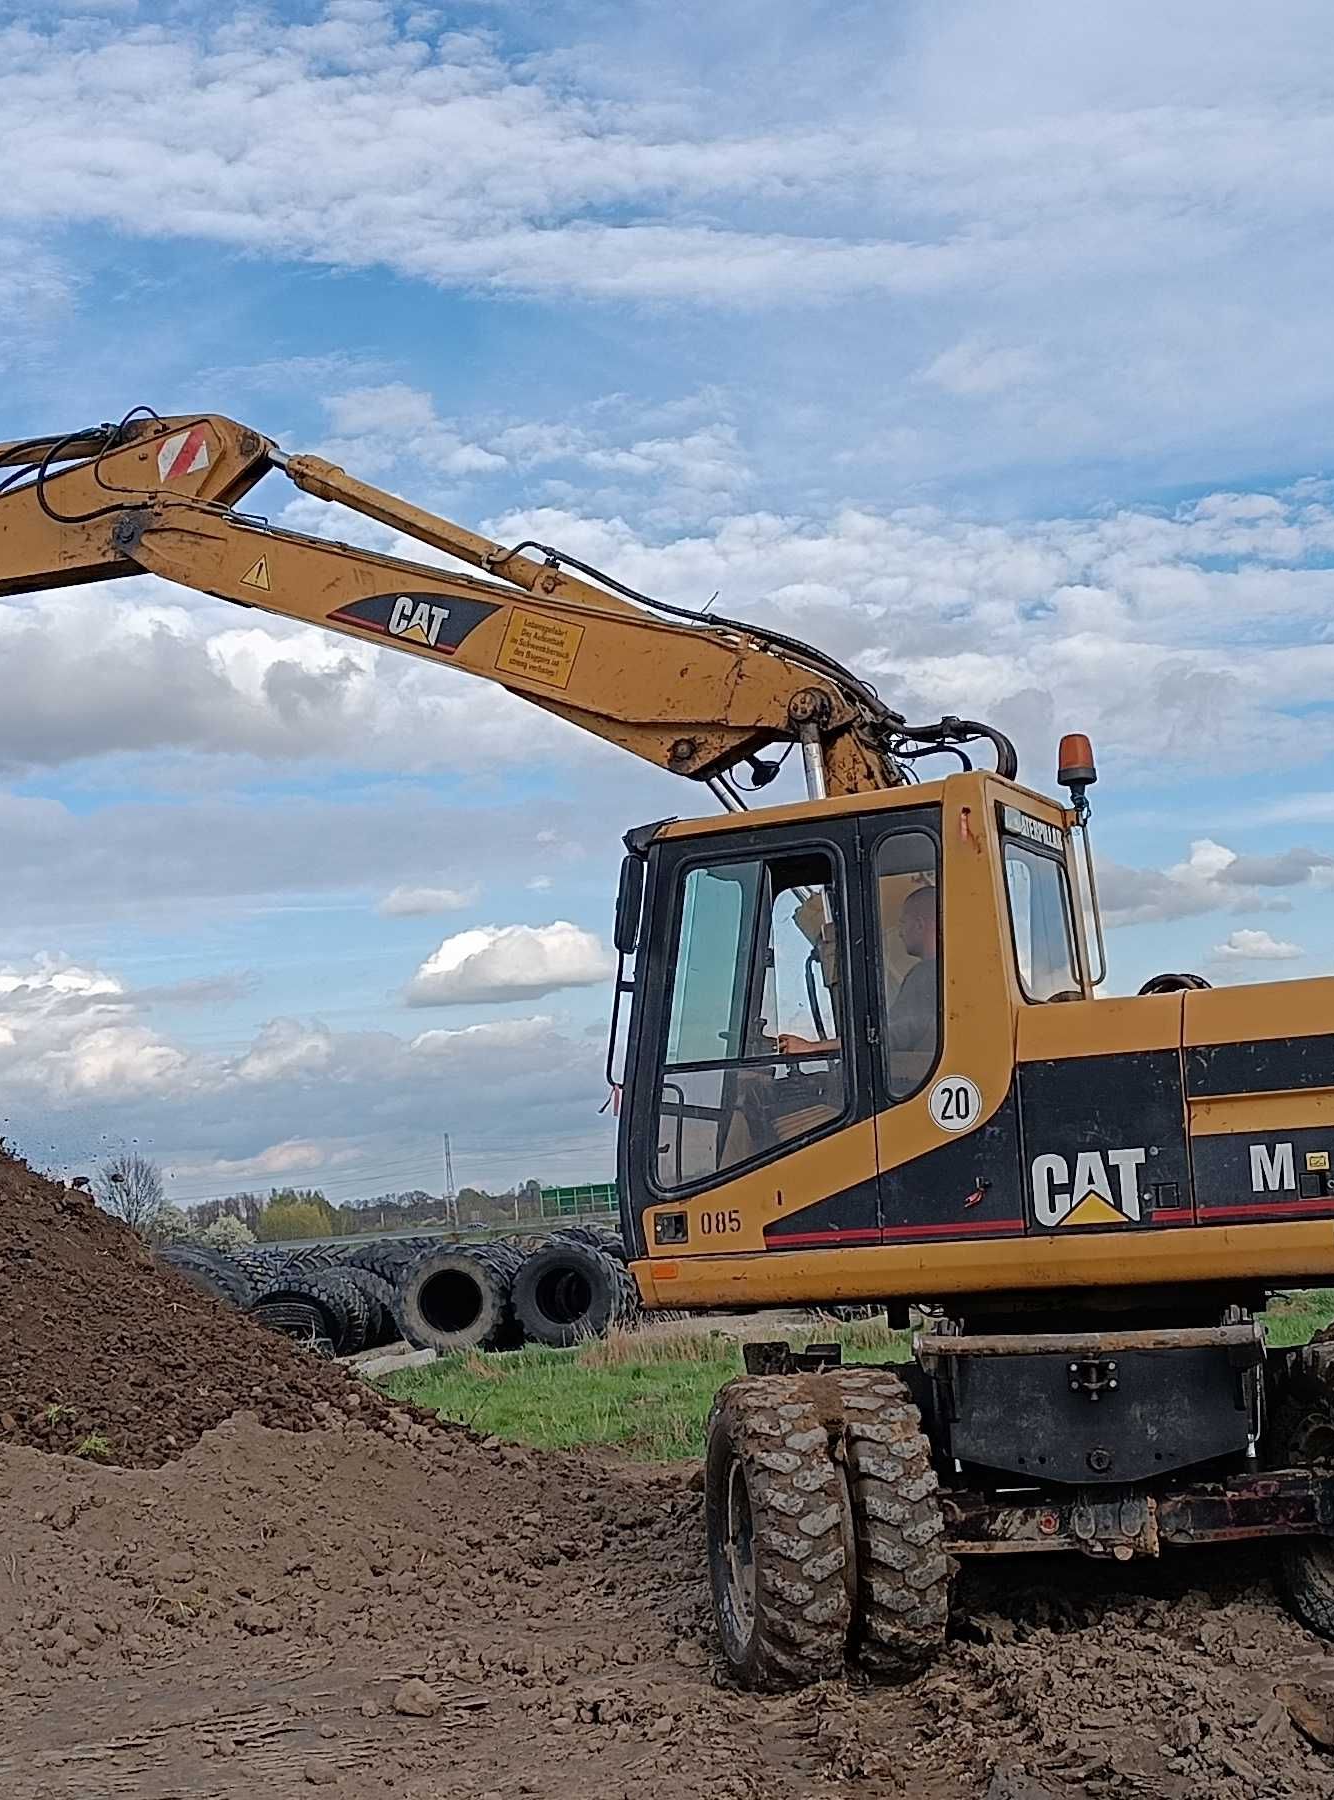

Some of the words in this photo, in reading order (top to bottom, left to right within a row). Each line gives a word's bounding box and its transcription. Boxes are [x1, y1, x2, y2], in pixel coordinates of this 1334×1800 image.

[388, 596, 450, 647] CAT
[940, 1086, 970, 1120] 20
[1032, 1148, 1146, 1227] CAT
[1249, 1142, 1296, 1193] M
[700, 1209, 742, 1234] 085
